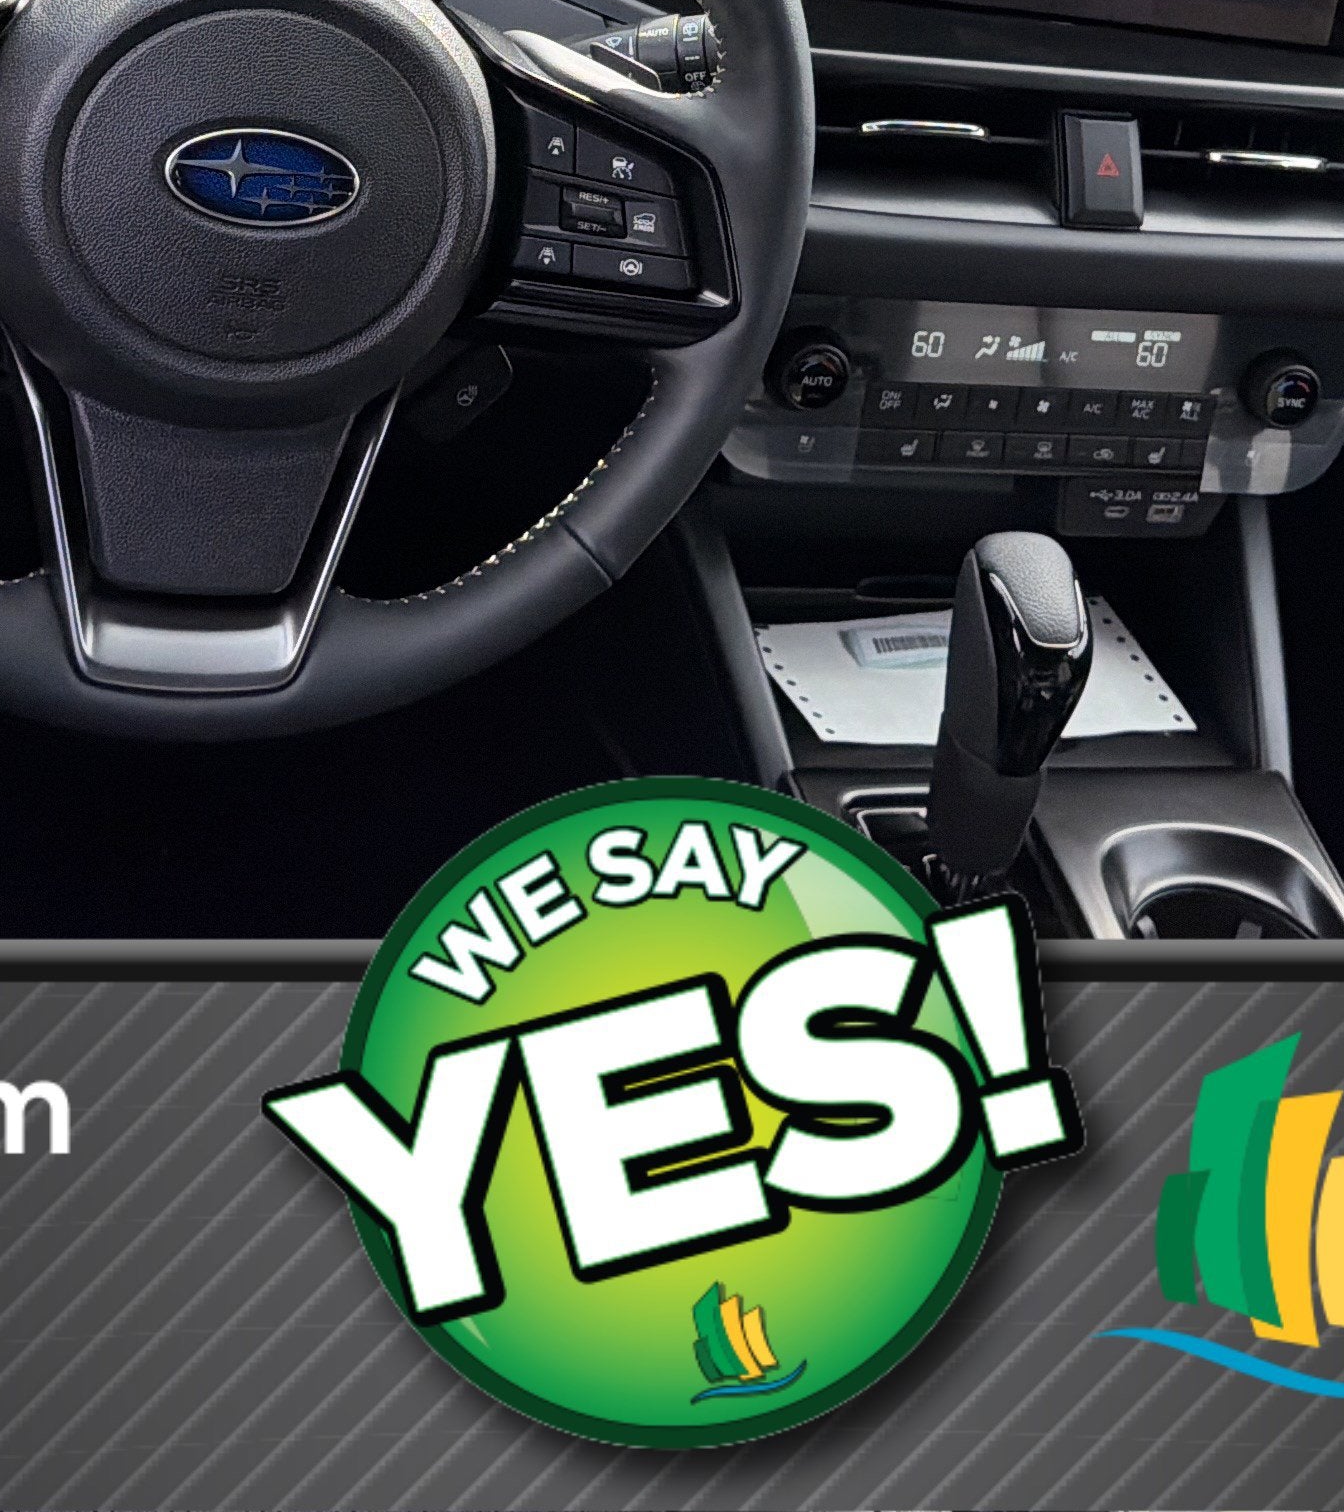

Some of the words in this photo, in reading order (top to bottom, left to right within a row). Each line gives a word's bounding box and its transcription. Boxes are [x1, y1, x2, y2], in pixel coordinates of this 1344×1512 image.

[684, 71, 707, 83] OFF
[911, 330, 945, 358] 60
[1059, 351, 1080, 364] A/C
[1136, 341, 1169, 368] 60
[801, 375, 833, 387] AUTO
[879, 399, 902, 410] OFF
[1083, 403, 1104, 415] A/C
[1131, 398, 1155, 410] MAX
[1277, 397, 1306, 409] SYNC
[1132, 408, 1152, 420] A/C
